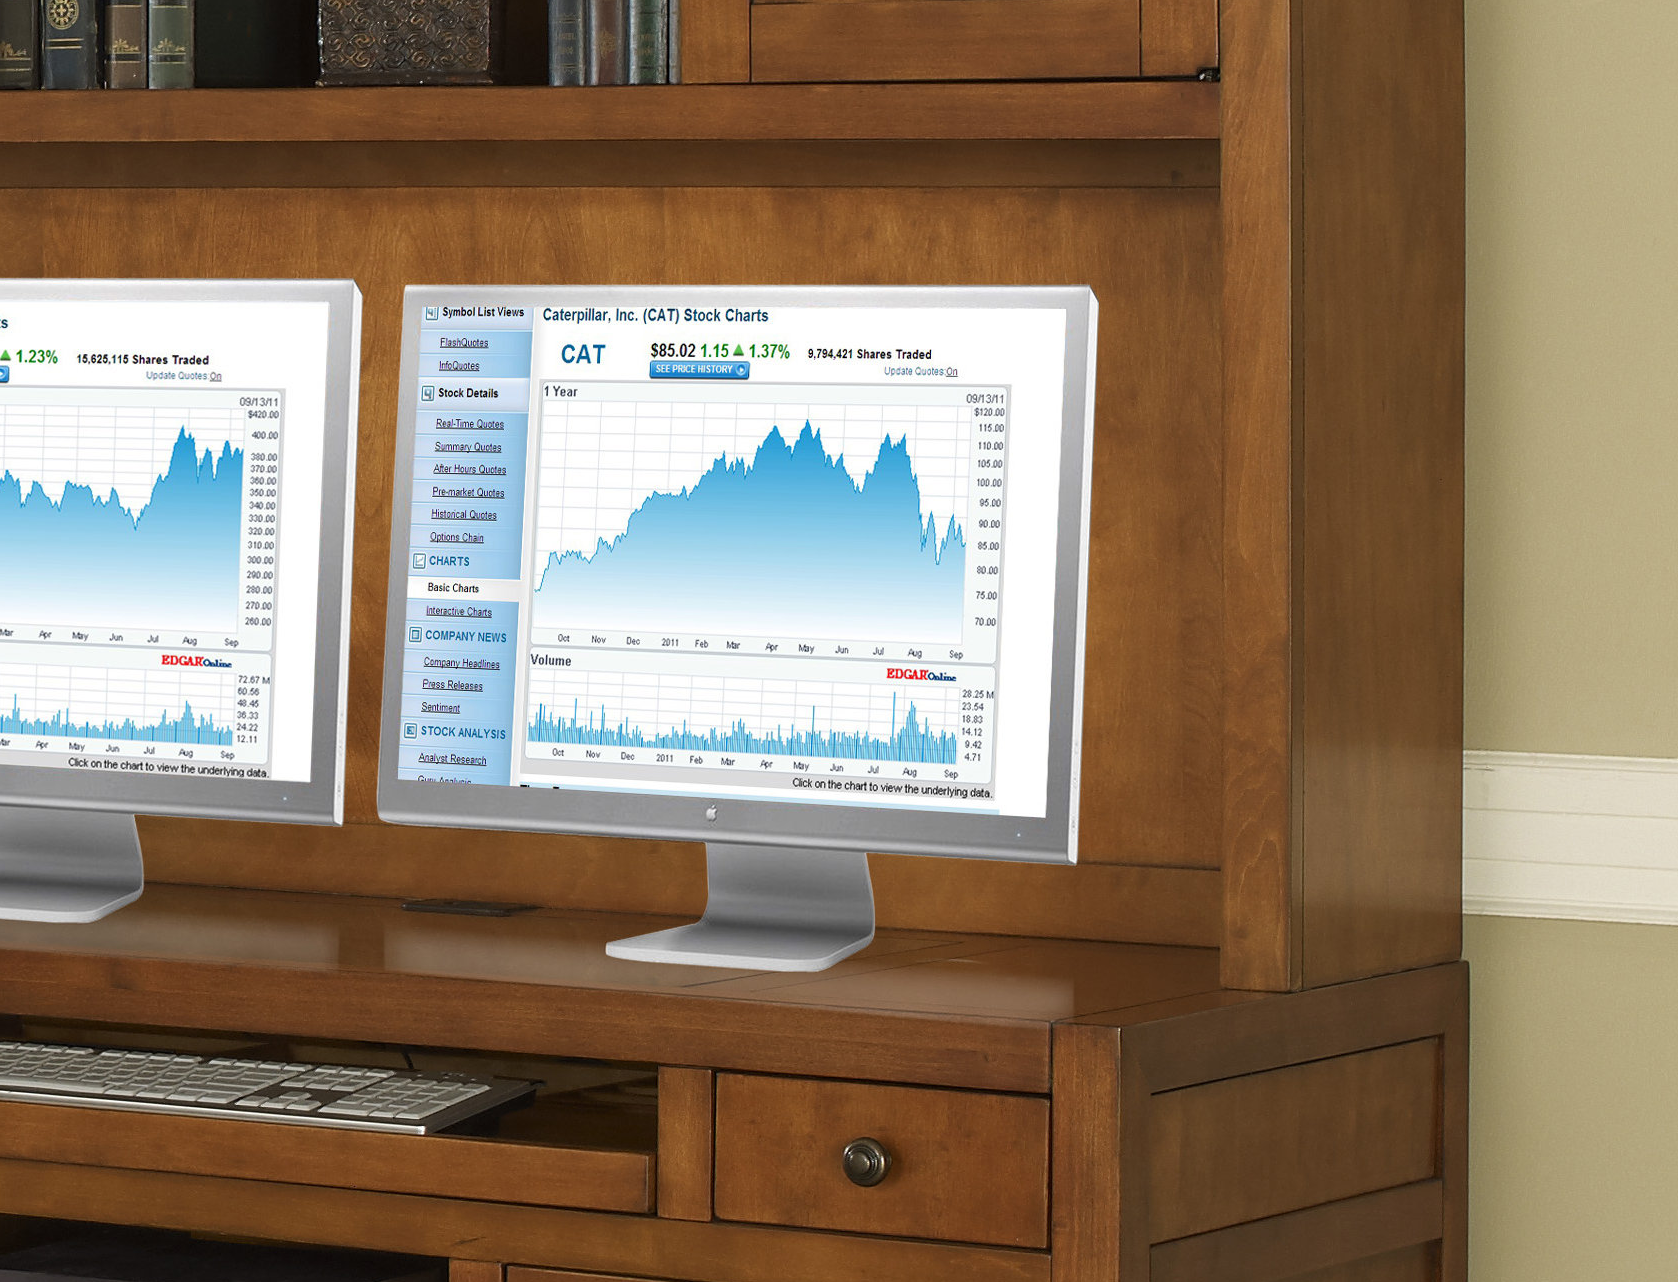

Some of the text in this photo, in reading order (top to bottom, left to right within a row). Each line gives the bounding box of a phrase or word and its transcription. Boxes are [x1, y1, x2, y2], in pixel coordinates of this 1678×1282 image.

[443, 307, 525, 318] Symbol List Views
[543, 308, 769, 324] Caterpillar, Inc. (CAT) Stock Charts
[440, 338, 489, 348] FlashQuotes
[561, 344, 606, 364] CAT
[650, 343, 790, 359] $85.02 1.15 1.37%
[808, 349, 931, 360] 9,794,421 Shares Traded
[16, 350, 58, 364] 1.23%
[77, 354, 209, 365] 15,625,115 Shares Traded
[439, 361, 480, 371] InfoQuotes
[656, 365, 733, 374] SEE PRICE HISTORY
[146, 371, 176, 381] Update
[884, 367, 913, 377] Update
[439, 388, 499, 398] Stock Details
[545, 386, 578, 397] 1 Year
[240, 397, 278, 407] 09/13/11
[966, 394, 1004, 404] 09/13/11
[248, 410, 279, 419] $420.00
[974, 407, 1005, 417] $120.00
[429, 556, 470, 566] CHARTS
[428, 582, 479, 593] Basic Charts
[426, 630, 507, 643] COMPANY NEWS
[531, 654, 571, 666] Volume
[963, 690, 994, 699] 28.25 M
[421, 726, 506, 739] STOCK ANALYSIS
[68, 757, 270, 778] Click on the chart to view the underlying data.
[793, 778, 993, 799] Click on the chart to view the underlying data.
